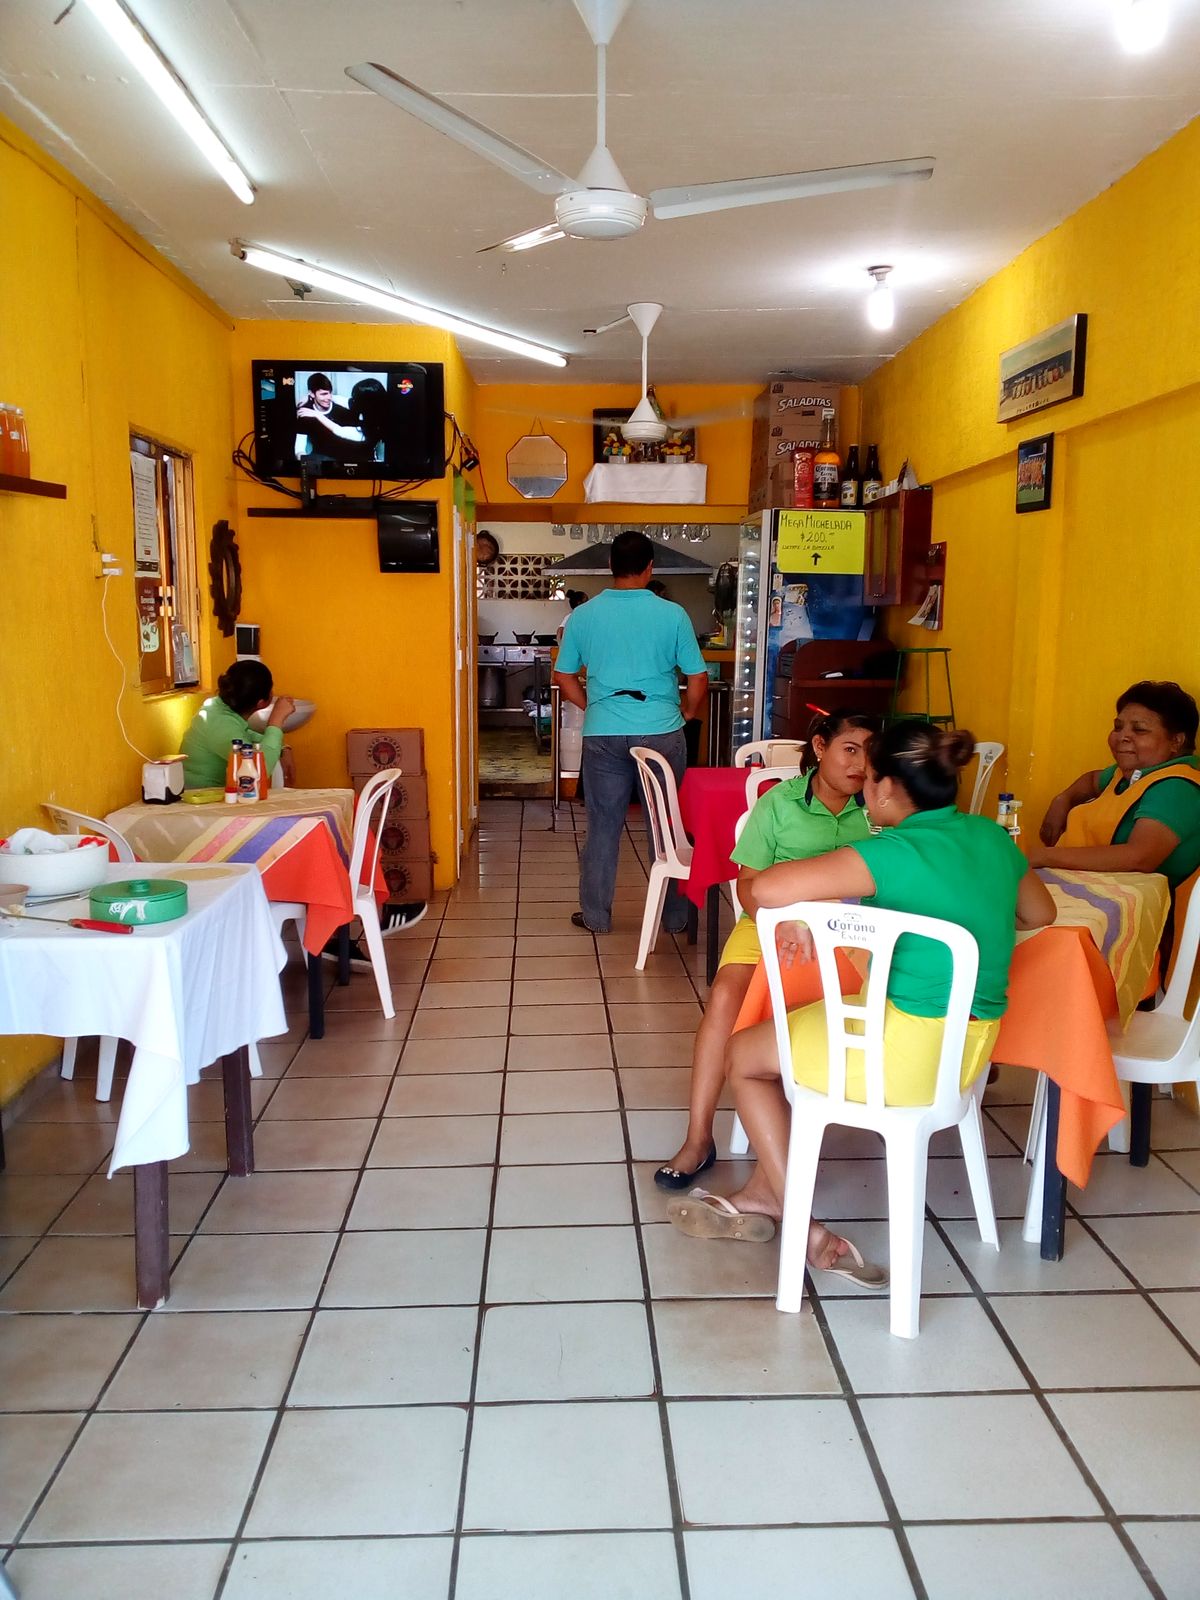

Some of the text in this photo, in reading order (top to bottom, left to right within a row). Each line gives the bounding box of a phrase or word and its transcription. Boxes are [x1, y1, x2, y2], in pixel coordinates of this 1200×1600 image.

[778, 397, 832, 412] SALADITAS
[776, 440, 821, 455] SALADIT
[781, 514, 852, 530] MEGA MICHELADA
[827, 918, 876, 933] Corona
